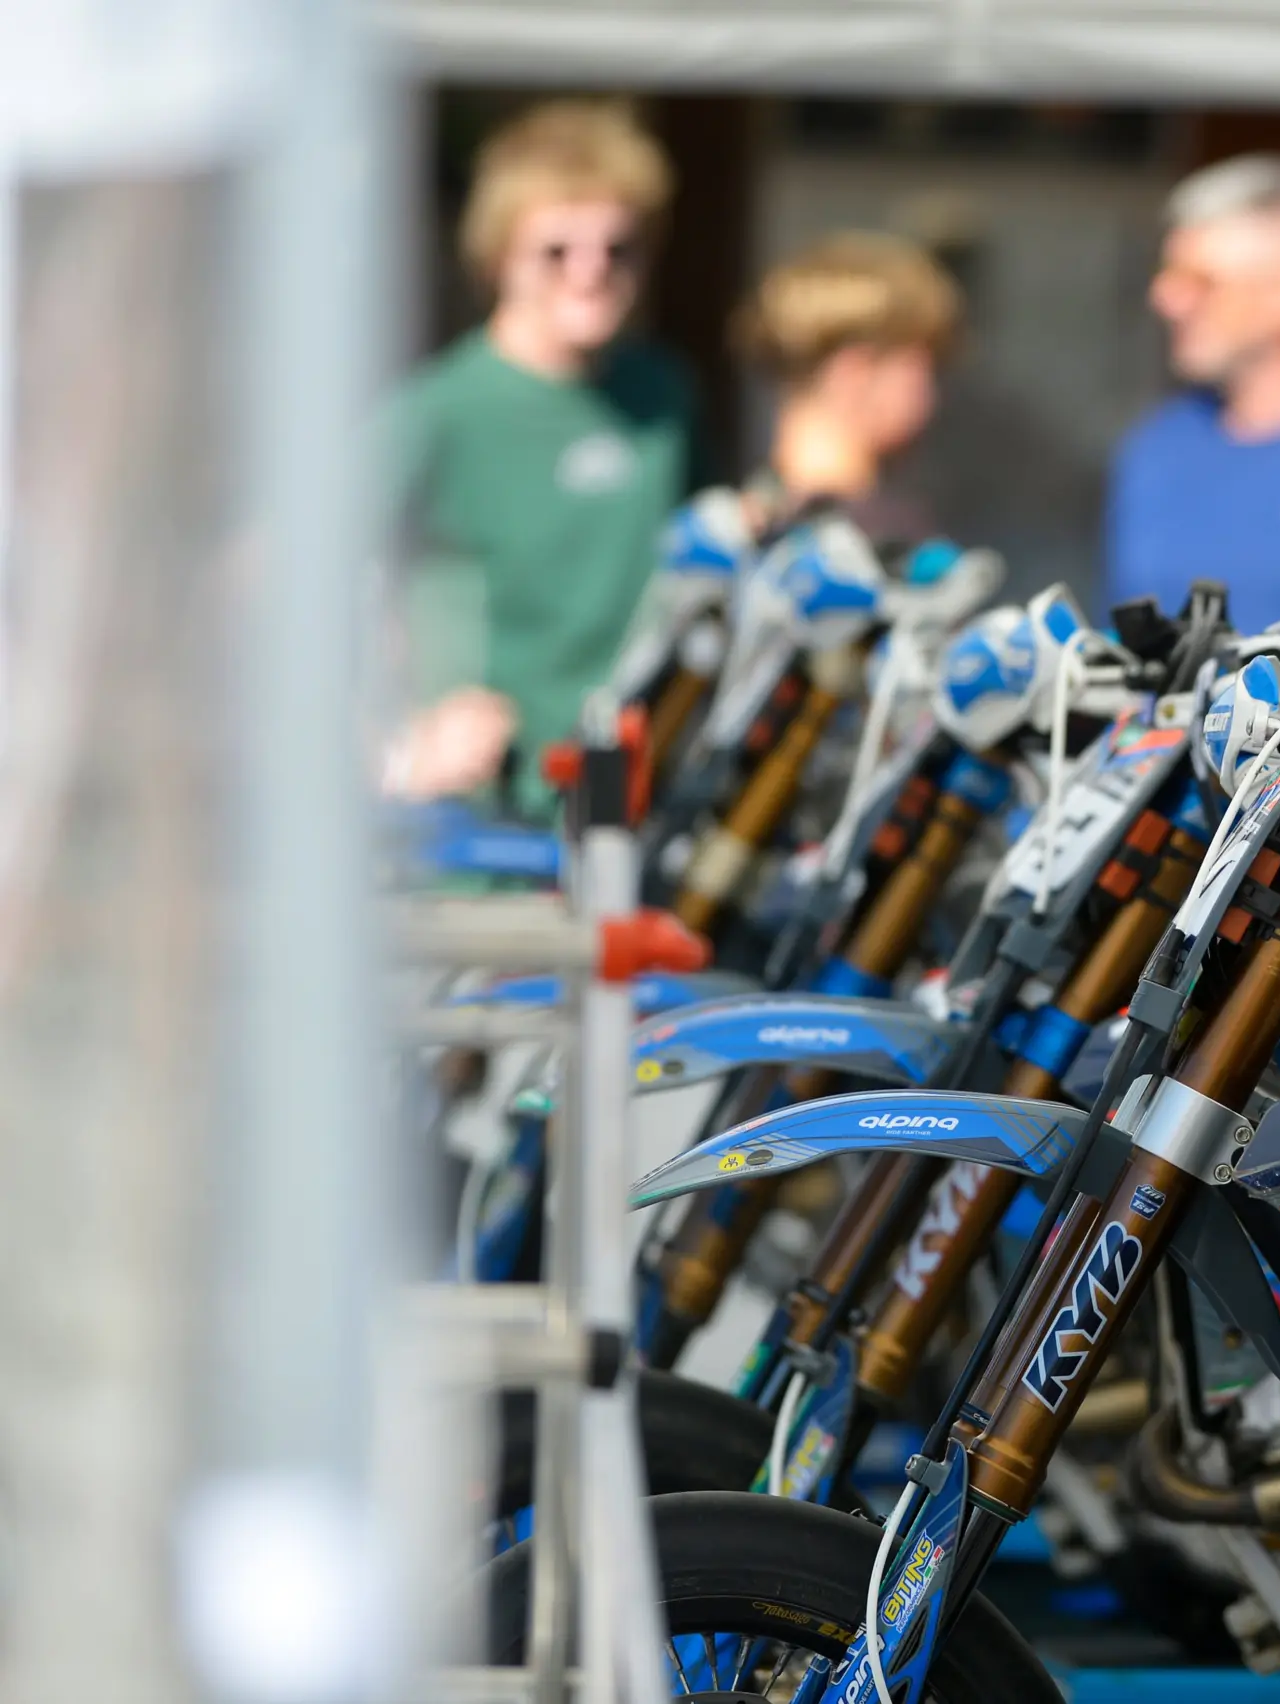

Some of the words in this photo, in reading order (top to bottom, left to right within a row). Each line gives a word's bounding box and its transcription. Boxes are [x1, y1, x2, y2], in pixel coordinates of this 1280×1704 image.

[858, 1113, 959, 1131] alpina
[1021, 1221, 1142, 1414] KYB
[883, 1536, 932, 1622] BITING
[752, 1601, 811, 1624] Takasago
